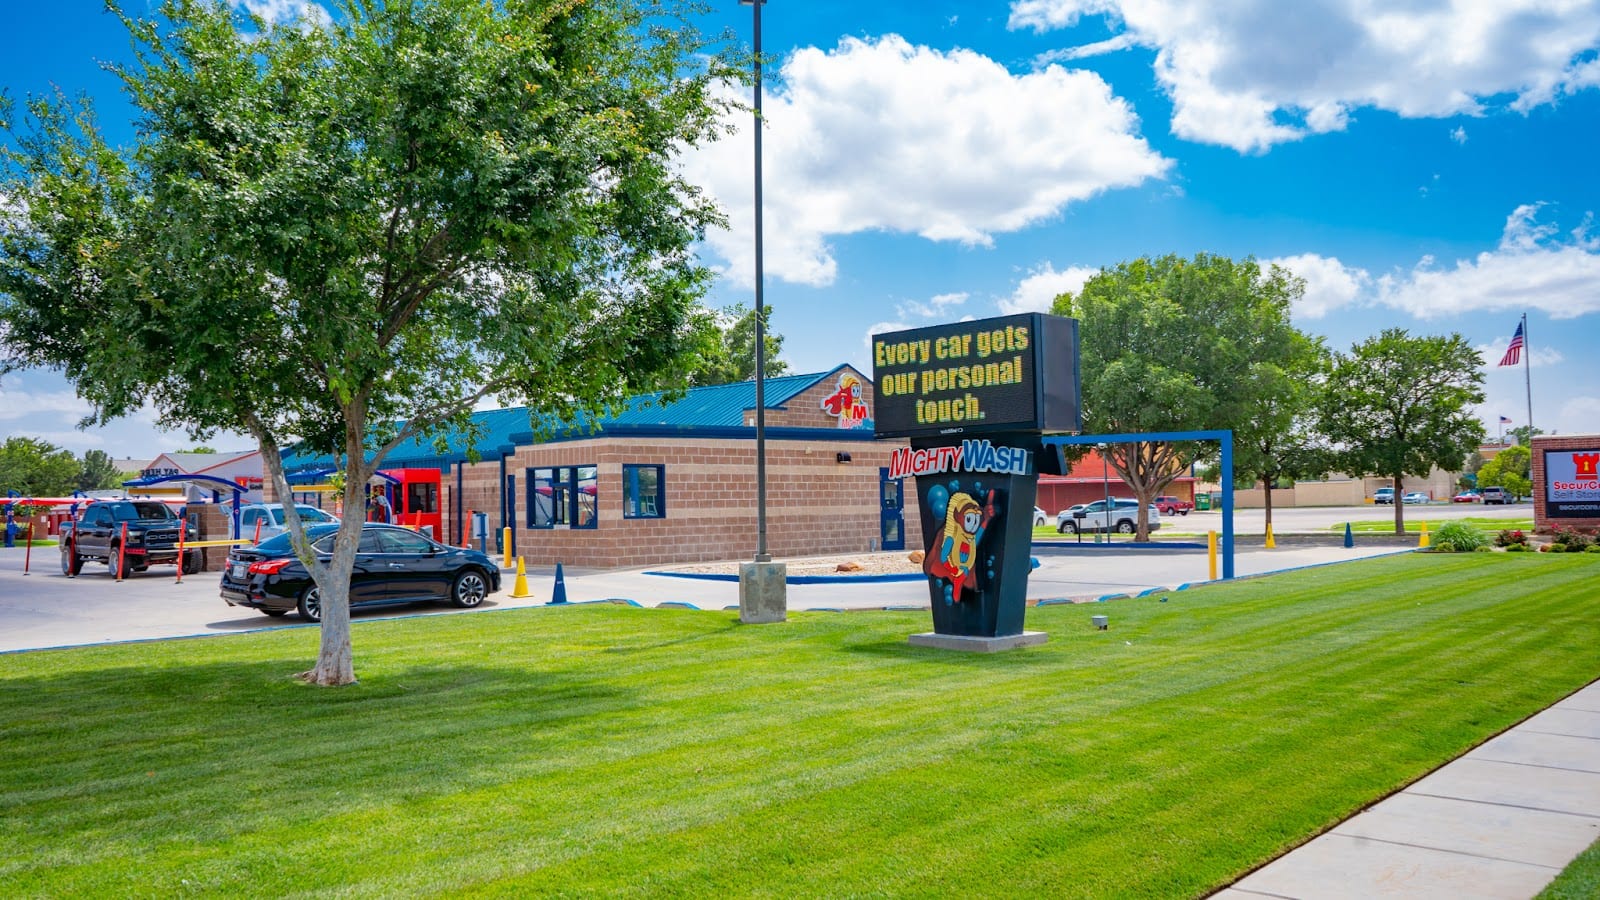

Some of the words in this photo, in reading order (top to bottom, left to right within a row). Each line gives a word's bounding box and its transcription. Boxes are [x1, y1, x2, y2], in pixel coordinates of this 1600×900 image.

[875, 339, 931, 367] Every
[935, 333, 972, 360] car
[976, 325, 1029, 358] gets
[882, 371, 917, 396] our
[921, 356, 1022, 394] personal
[916, 393, 985, 424] touch.
[1554, 481, 1600, 490] SecurC
